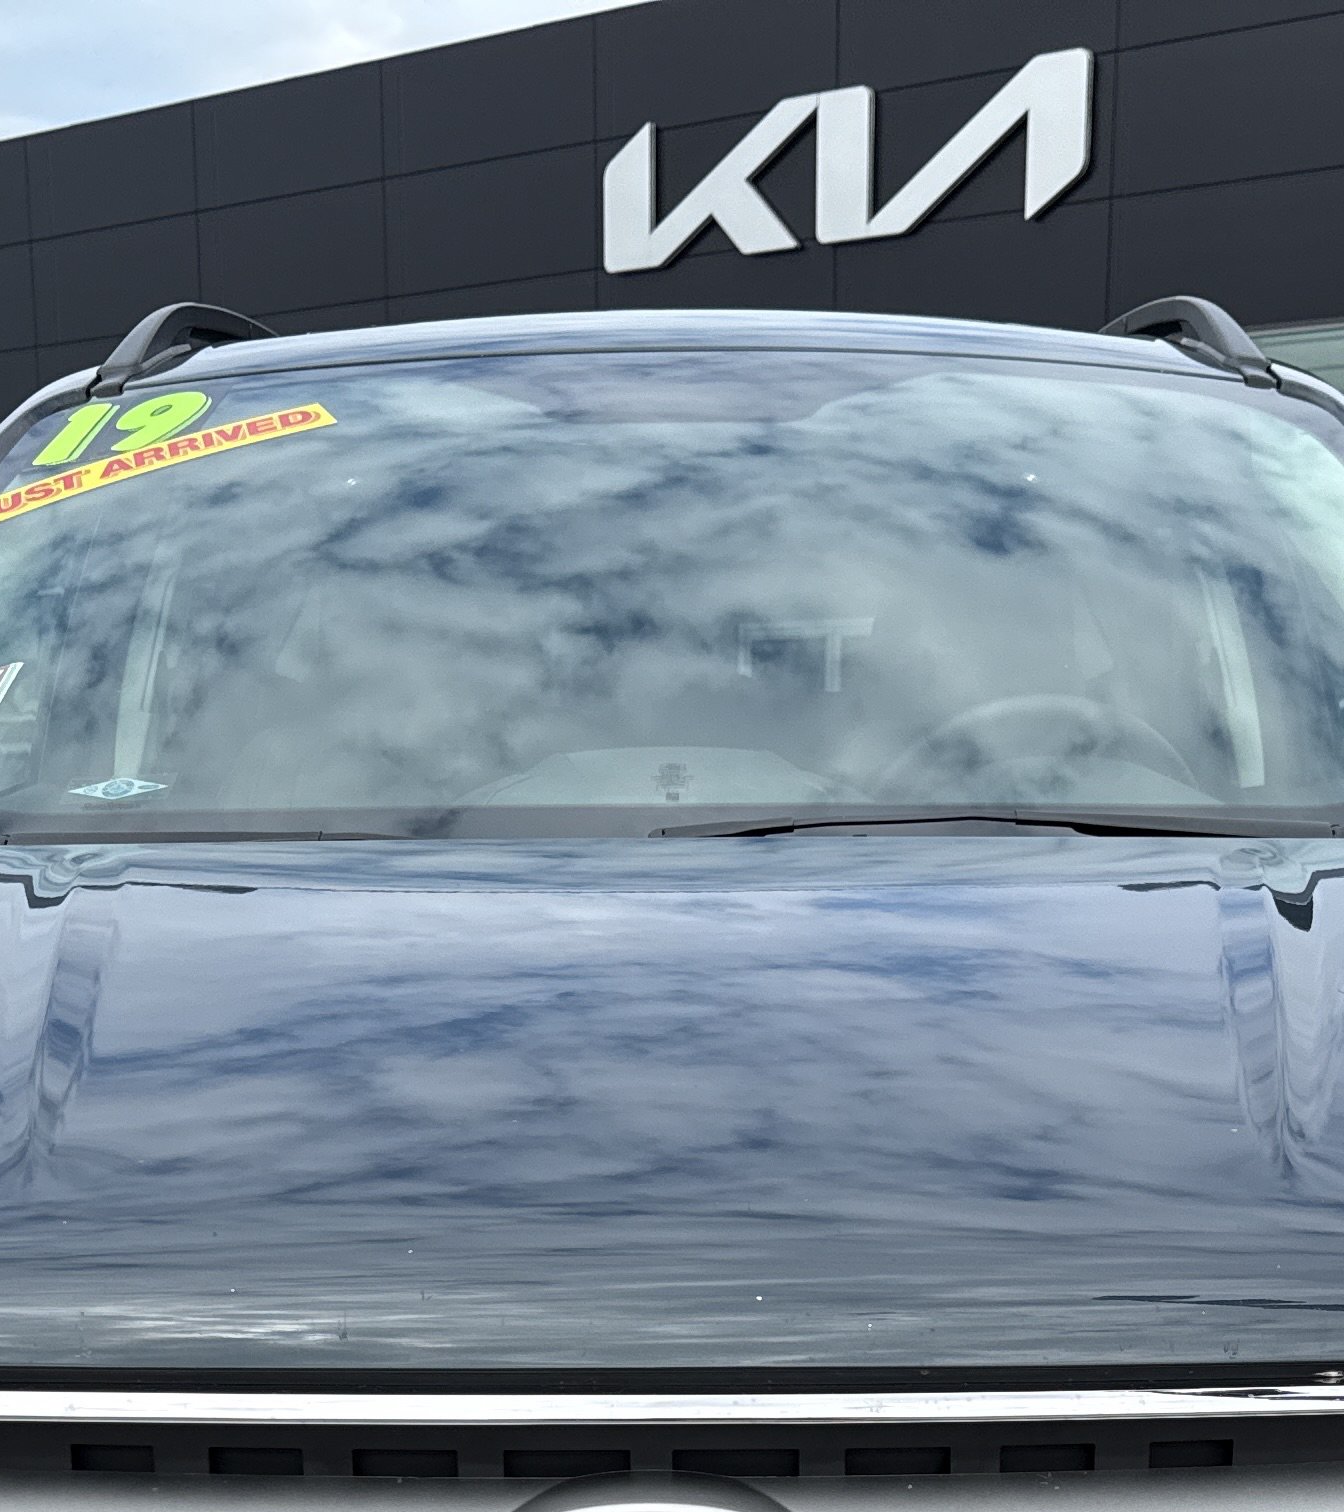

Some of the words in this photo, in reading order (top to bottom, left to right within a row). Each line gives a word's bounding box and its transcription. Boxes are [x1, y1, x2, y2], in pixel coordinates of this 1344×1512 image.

[603, 47, 1094, 275] KIA
[32, 391, 212, 466] 19
[99, 410, 321, 480] ARRIVED
